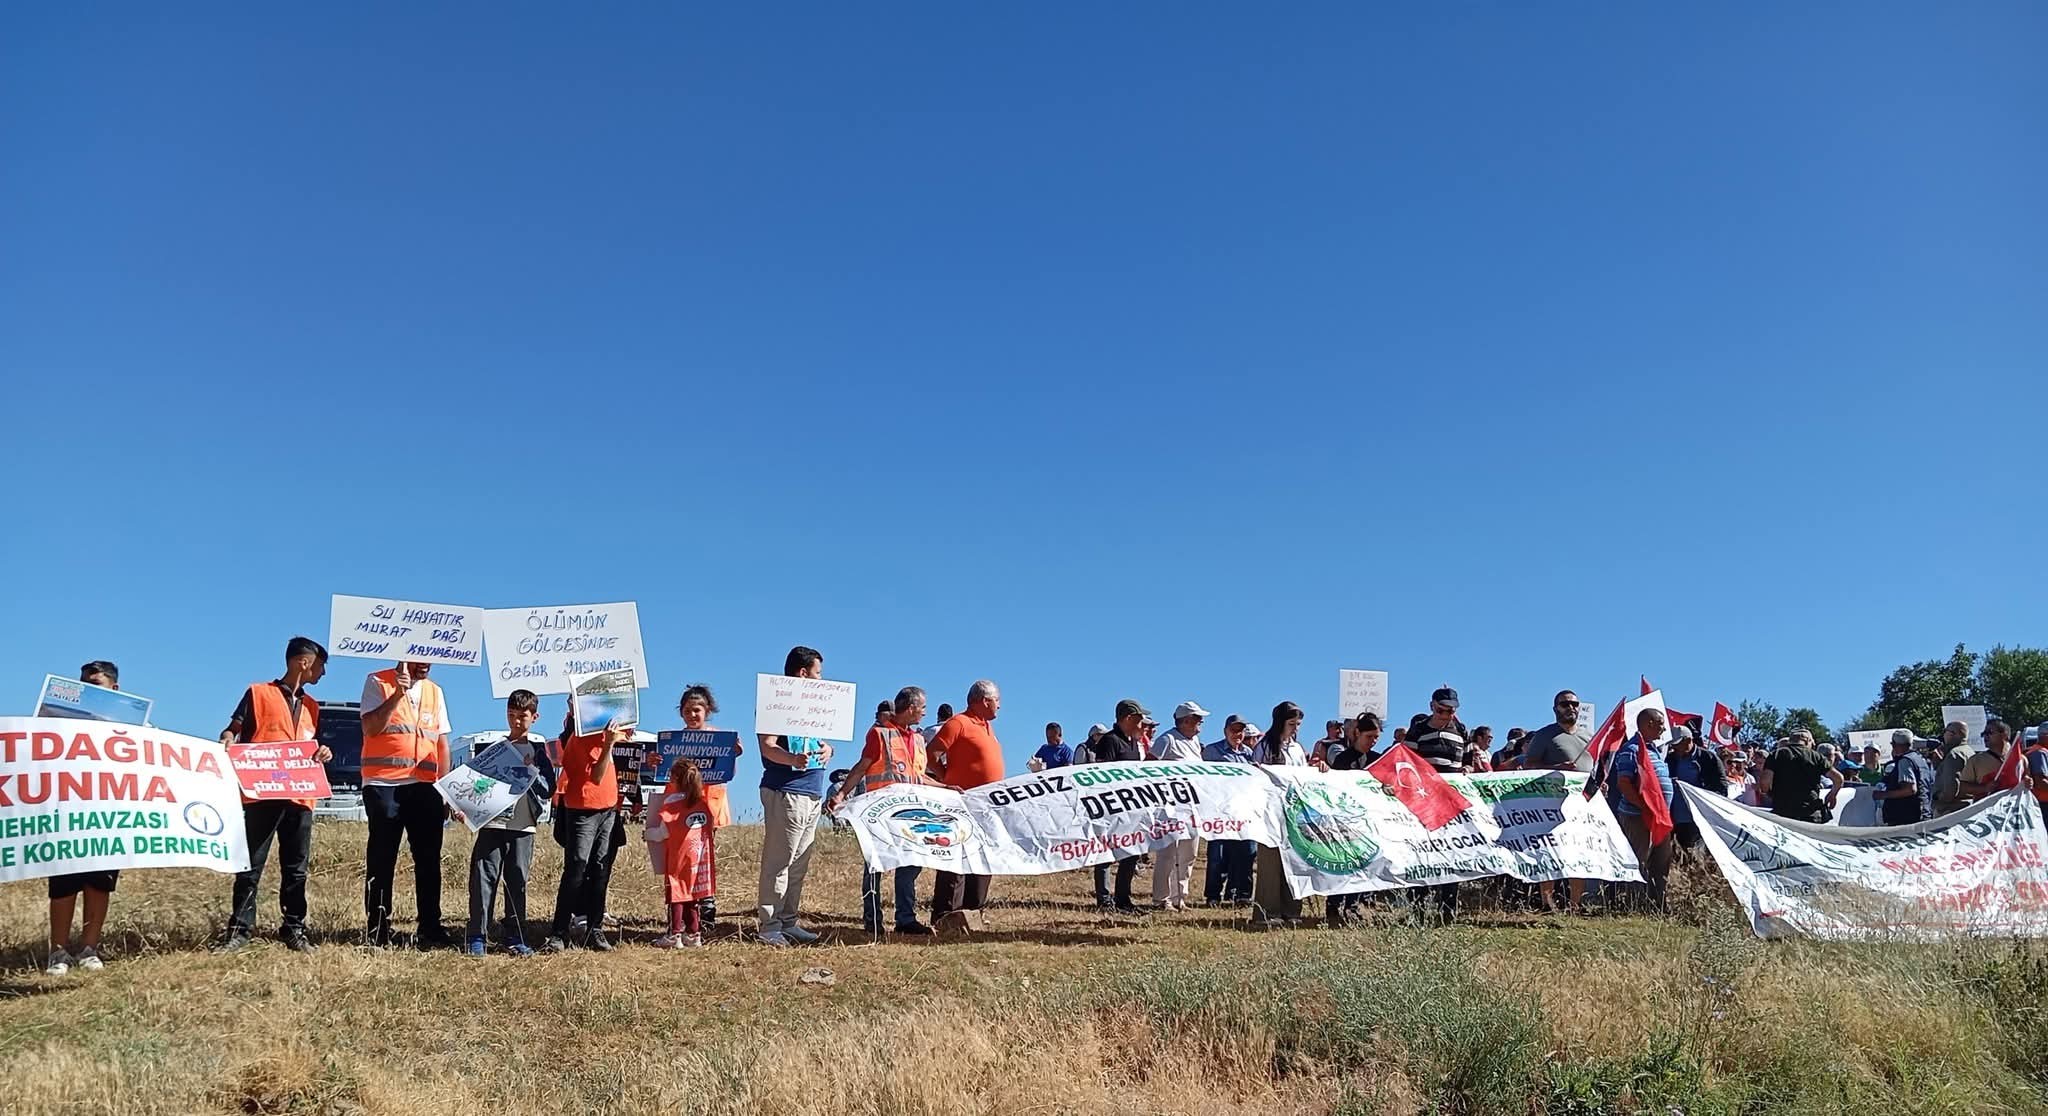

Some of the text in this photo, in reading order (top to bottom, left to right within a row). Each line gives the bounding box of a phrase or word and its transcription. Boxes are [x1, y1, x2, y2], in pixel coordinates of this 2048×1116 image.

[371, 604, 465, 628] SU HAYATTIR
[527, 610, 608, 631] ÖLÜMÜN
[355, 621, 466, 644] MURAT DAĞI
[338, 637, 390, 654] SUYUN
[516, 633, 619, 655] GÖLGESİNDE
[500, 660, 549, 681] ÖZGÜR
[681, 732, 715, 743] HAYATI
[287, 747, 304, 758] DA
[663, 744, 732, 757] SAVUNUYORUZ
[988, 775, 1073, 807] GEDİZ
[1080, 777, 1201, 820] DERNEĞİ
[68, 811, 169, 831] HAVZASI
[0, 846, 16, 868] E
[24, 836, 126, 865] KORUMA
